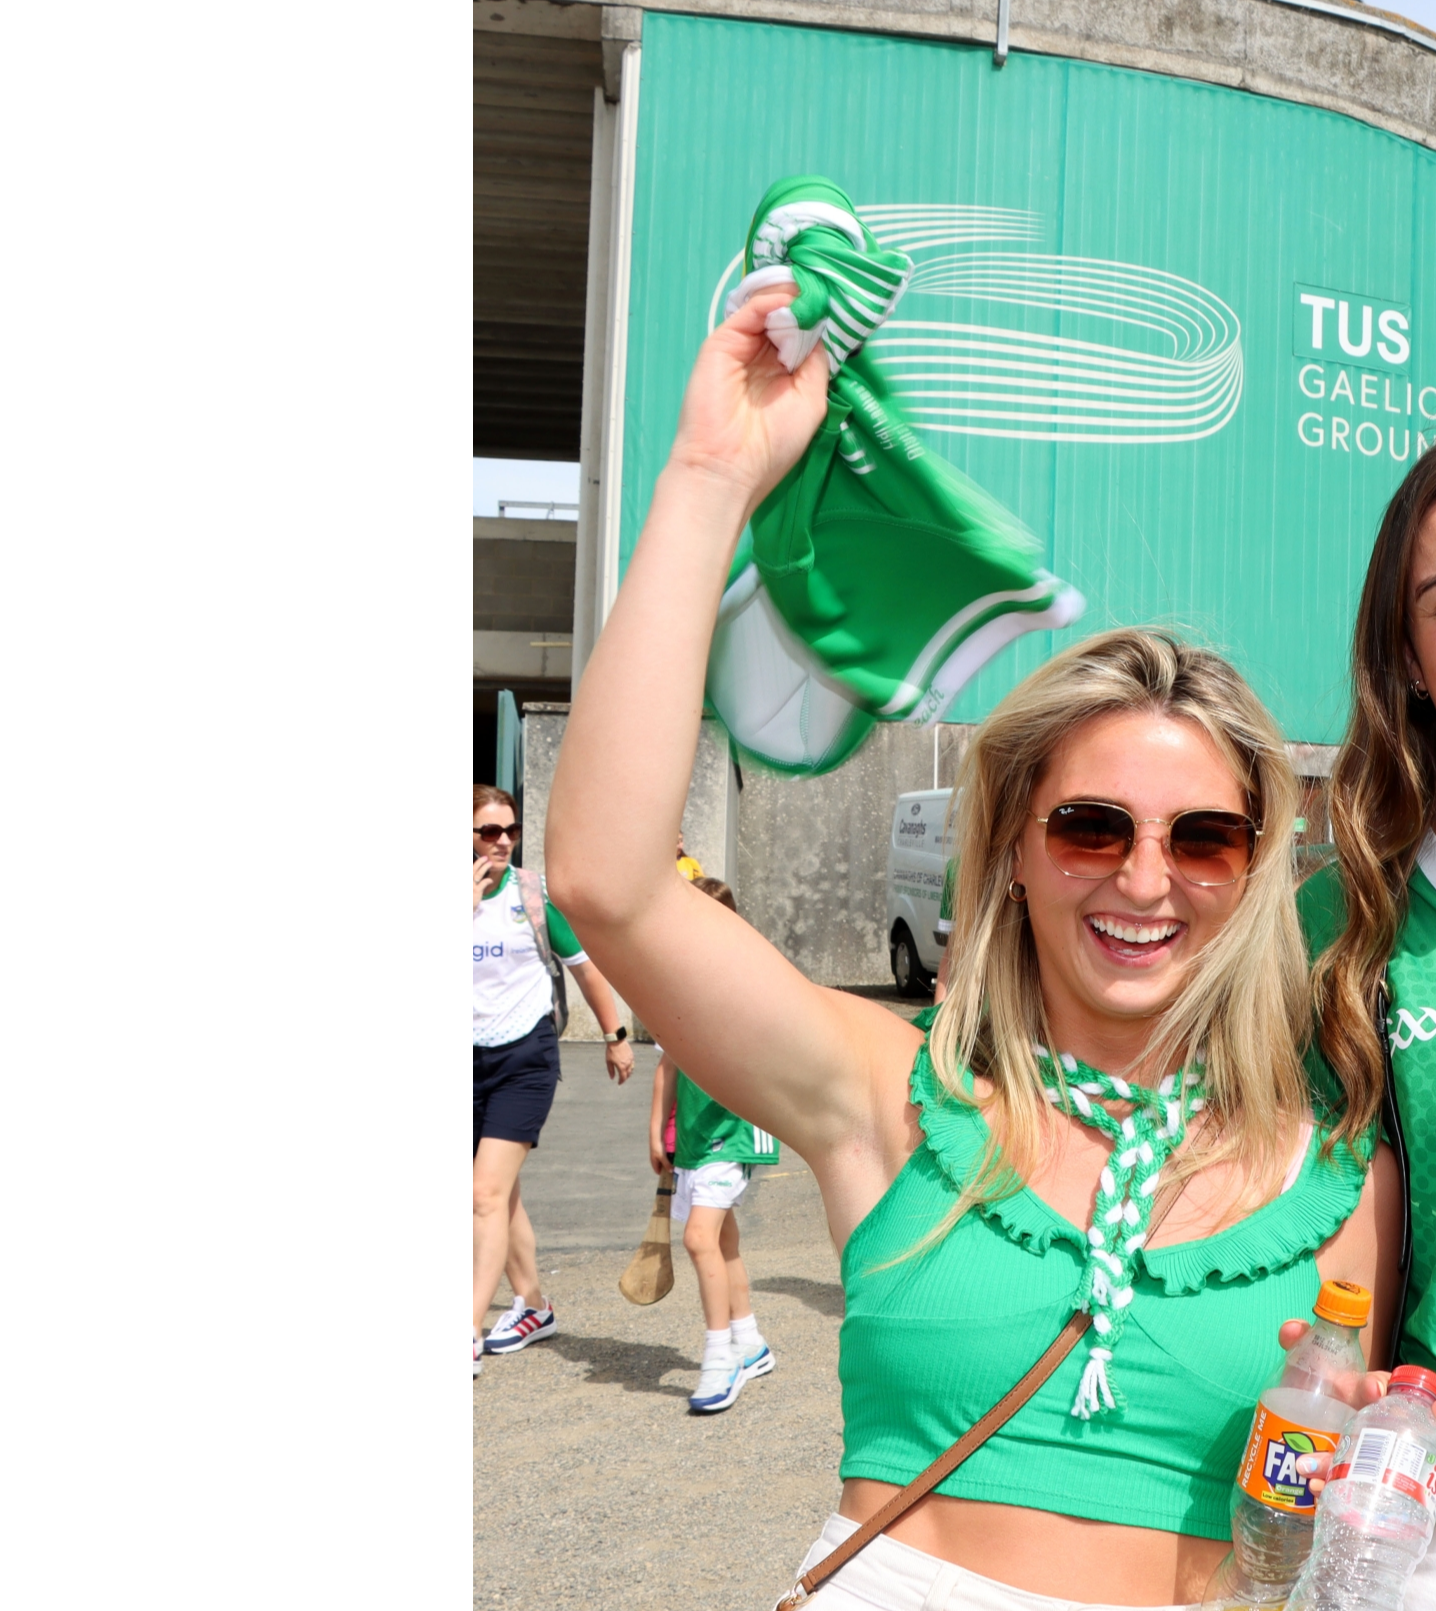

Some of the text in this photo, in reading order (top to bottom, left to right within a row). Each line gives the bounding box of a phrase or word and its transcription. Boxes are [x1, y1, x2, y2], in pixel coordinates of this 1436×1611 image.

[1300, 293, 1410, 365] TUS
[1241, 1433, 1261, 1488] RECYCLE
[1257, 1410, 1267, 1431] ME
[1264, 1440, 1308, 1485] FA
[1262, 1492, 1273, 1500] Low
[1275, 1485, 1304, 1495] Orange
